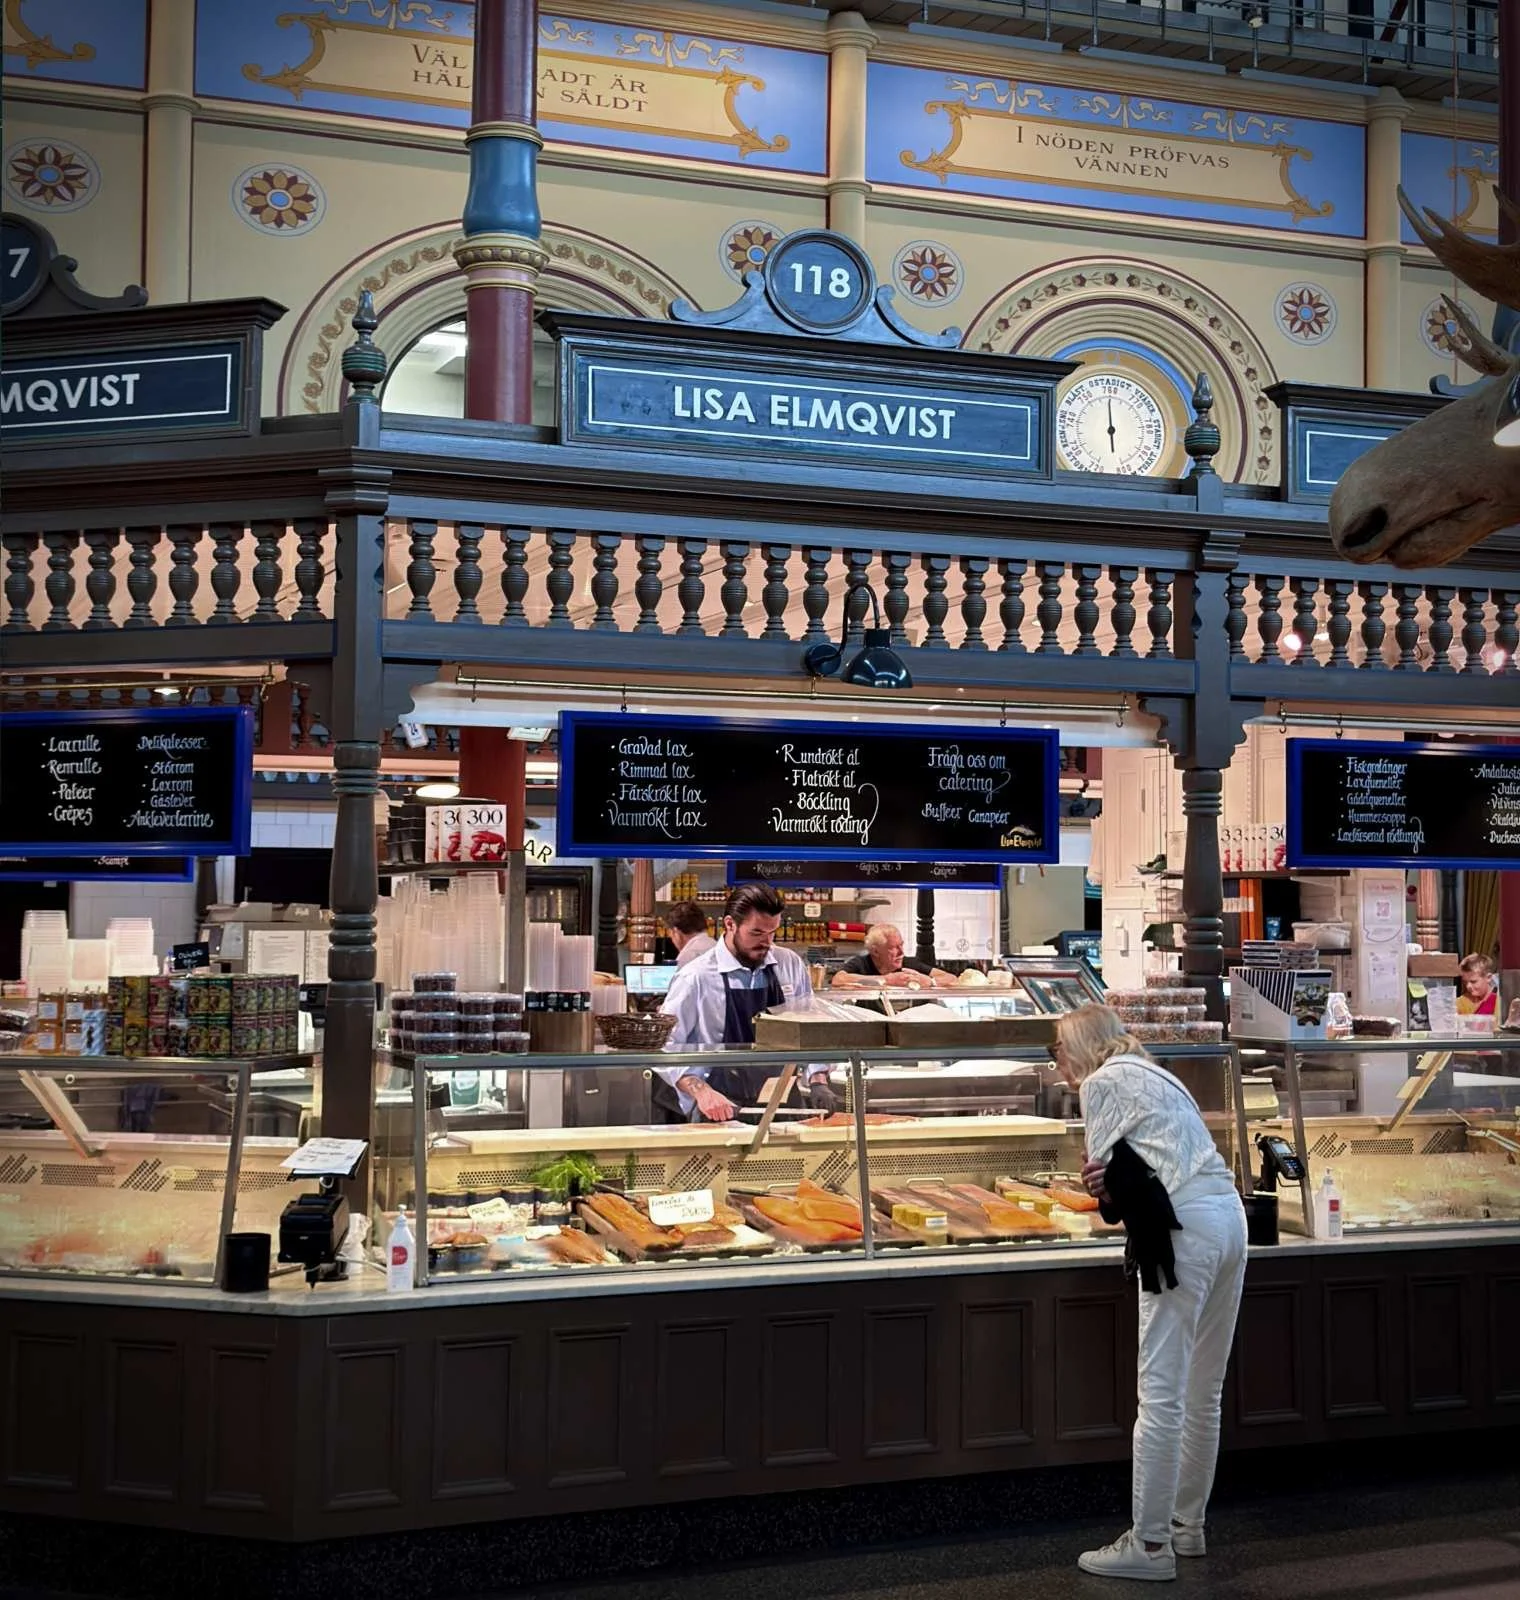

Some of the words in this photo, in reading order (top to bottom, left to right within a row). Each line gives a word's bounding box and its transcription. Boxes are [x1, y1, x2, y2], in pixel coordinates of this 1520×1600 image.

[610, 73, 648, 94] ÄR
[560, 87, 649, 113] SÅLDT
[1016, 125, 1024, 144] I
[1035, 131, 1115, 155] NÖDEN
[1129, 144, 1230, 169] PRÖFVAS
[1073, 154, 1169, 179] VÄNNEN
[8, 247, 30, 279] 7
[789, 262, 851, 299] 118
[1077, 391, 1093, 404] 750
[1128, 394, 1144, 409] 770
[673, 384, 757, 424] LISA
[769, 393, 956, 440] ELMQVIST
[48, 734, 102, 752] Laxrulle
[618, 735, 663, 756] Gravad
[666, 739, 694, 758] lax
[47, 757, 102, 781] Renrulle
[618, 760, 668, 779] Rimmad
[671, 762, 696, 779] lax
[927, 744, 965, 774] Fråga
[966, 753, 986, 769] oss
[988, 754, 1006, 769] om
[150, 778, 193, 792] Laxrom
[682, 784, 707, 804] lax
[939, 771, 1012, 804] catering
[466, 808, 503, 826] 300
